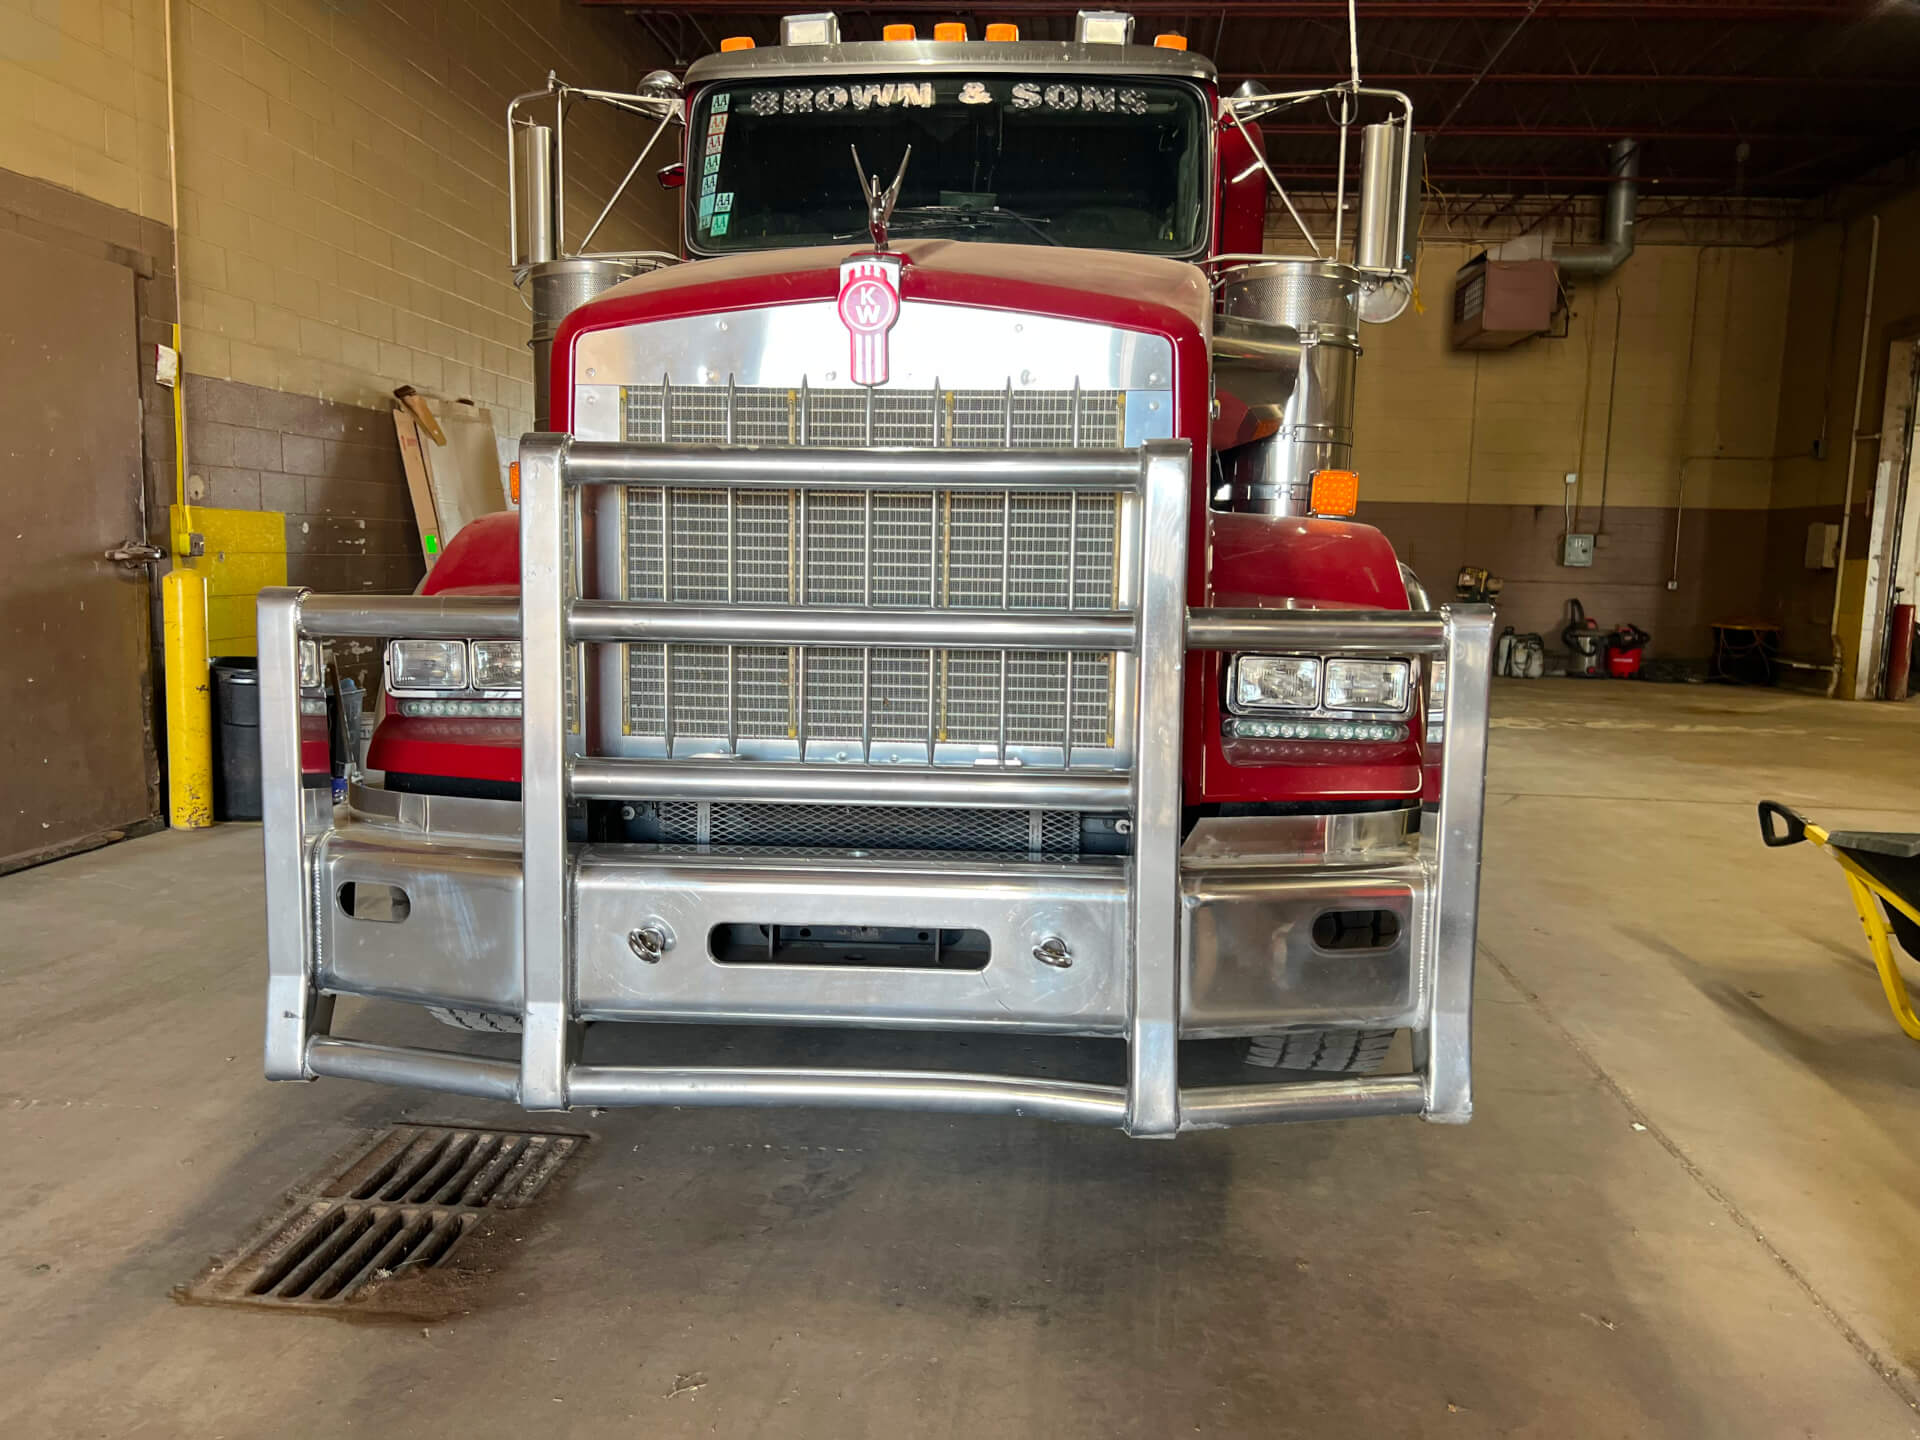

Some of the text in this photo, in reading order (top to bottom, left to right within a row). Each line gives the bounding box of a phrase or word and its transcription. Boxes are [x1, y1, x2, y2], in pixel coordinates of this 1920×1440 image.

[750, 82, 1149, 116] BROWN & SONS
